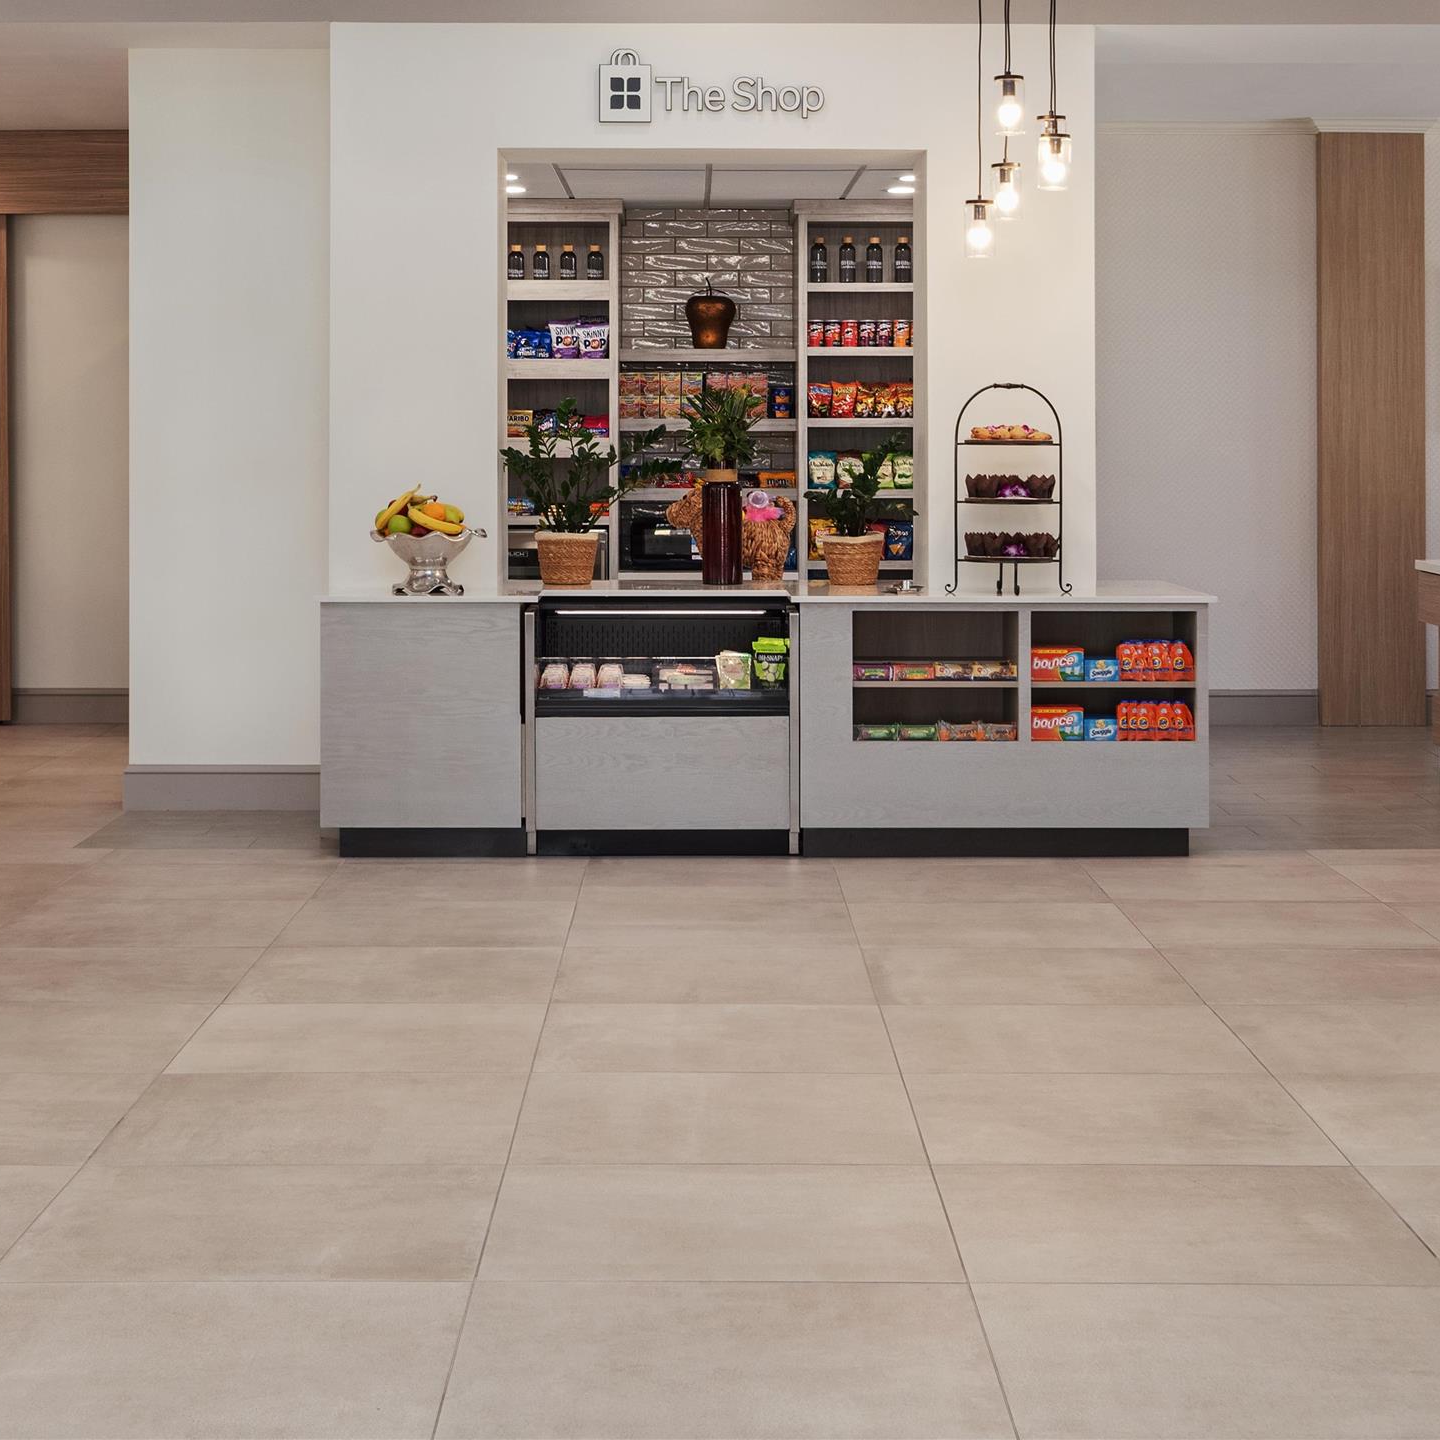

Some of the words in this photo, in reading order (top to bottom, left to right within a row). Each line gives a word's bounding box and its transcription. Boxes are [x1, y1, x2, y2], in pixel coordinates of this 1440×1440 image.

[655, 76, 726, 111] The
[731, 75, 825, 119] Shop
[582, 328, 606, 339] SKINNY
[556, 335, 579, 346] POP
[584, 339, 606, 349] POP
[1033, 655, 1076, 670] bounce
[1033, 715, 1075, 729] bounce
